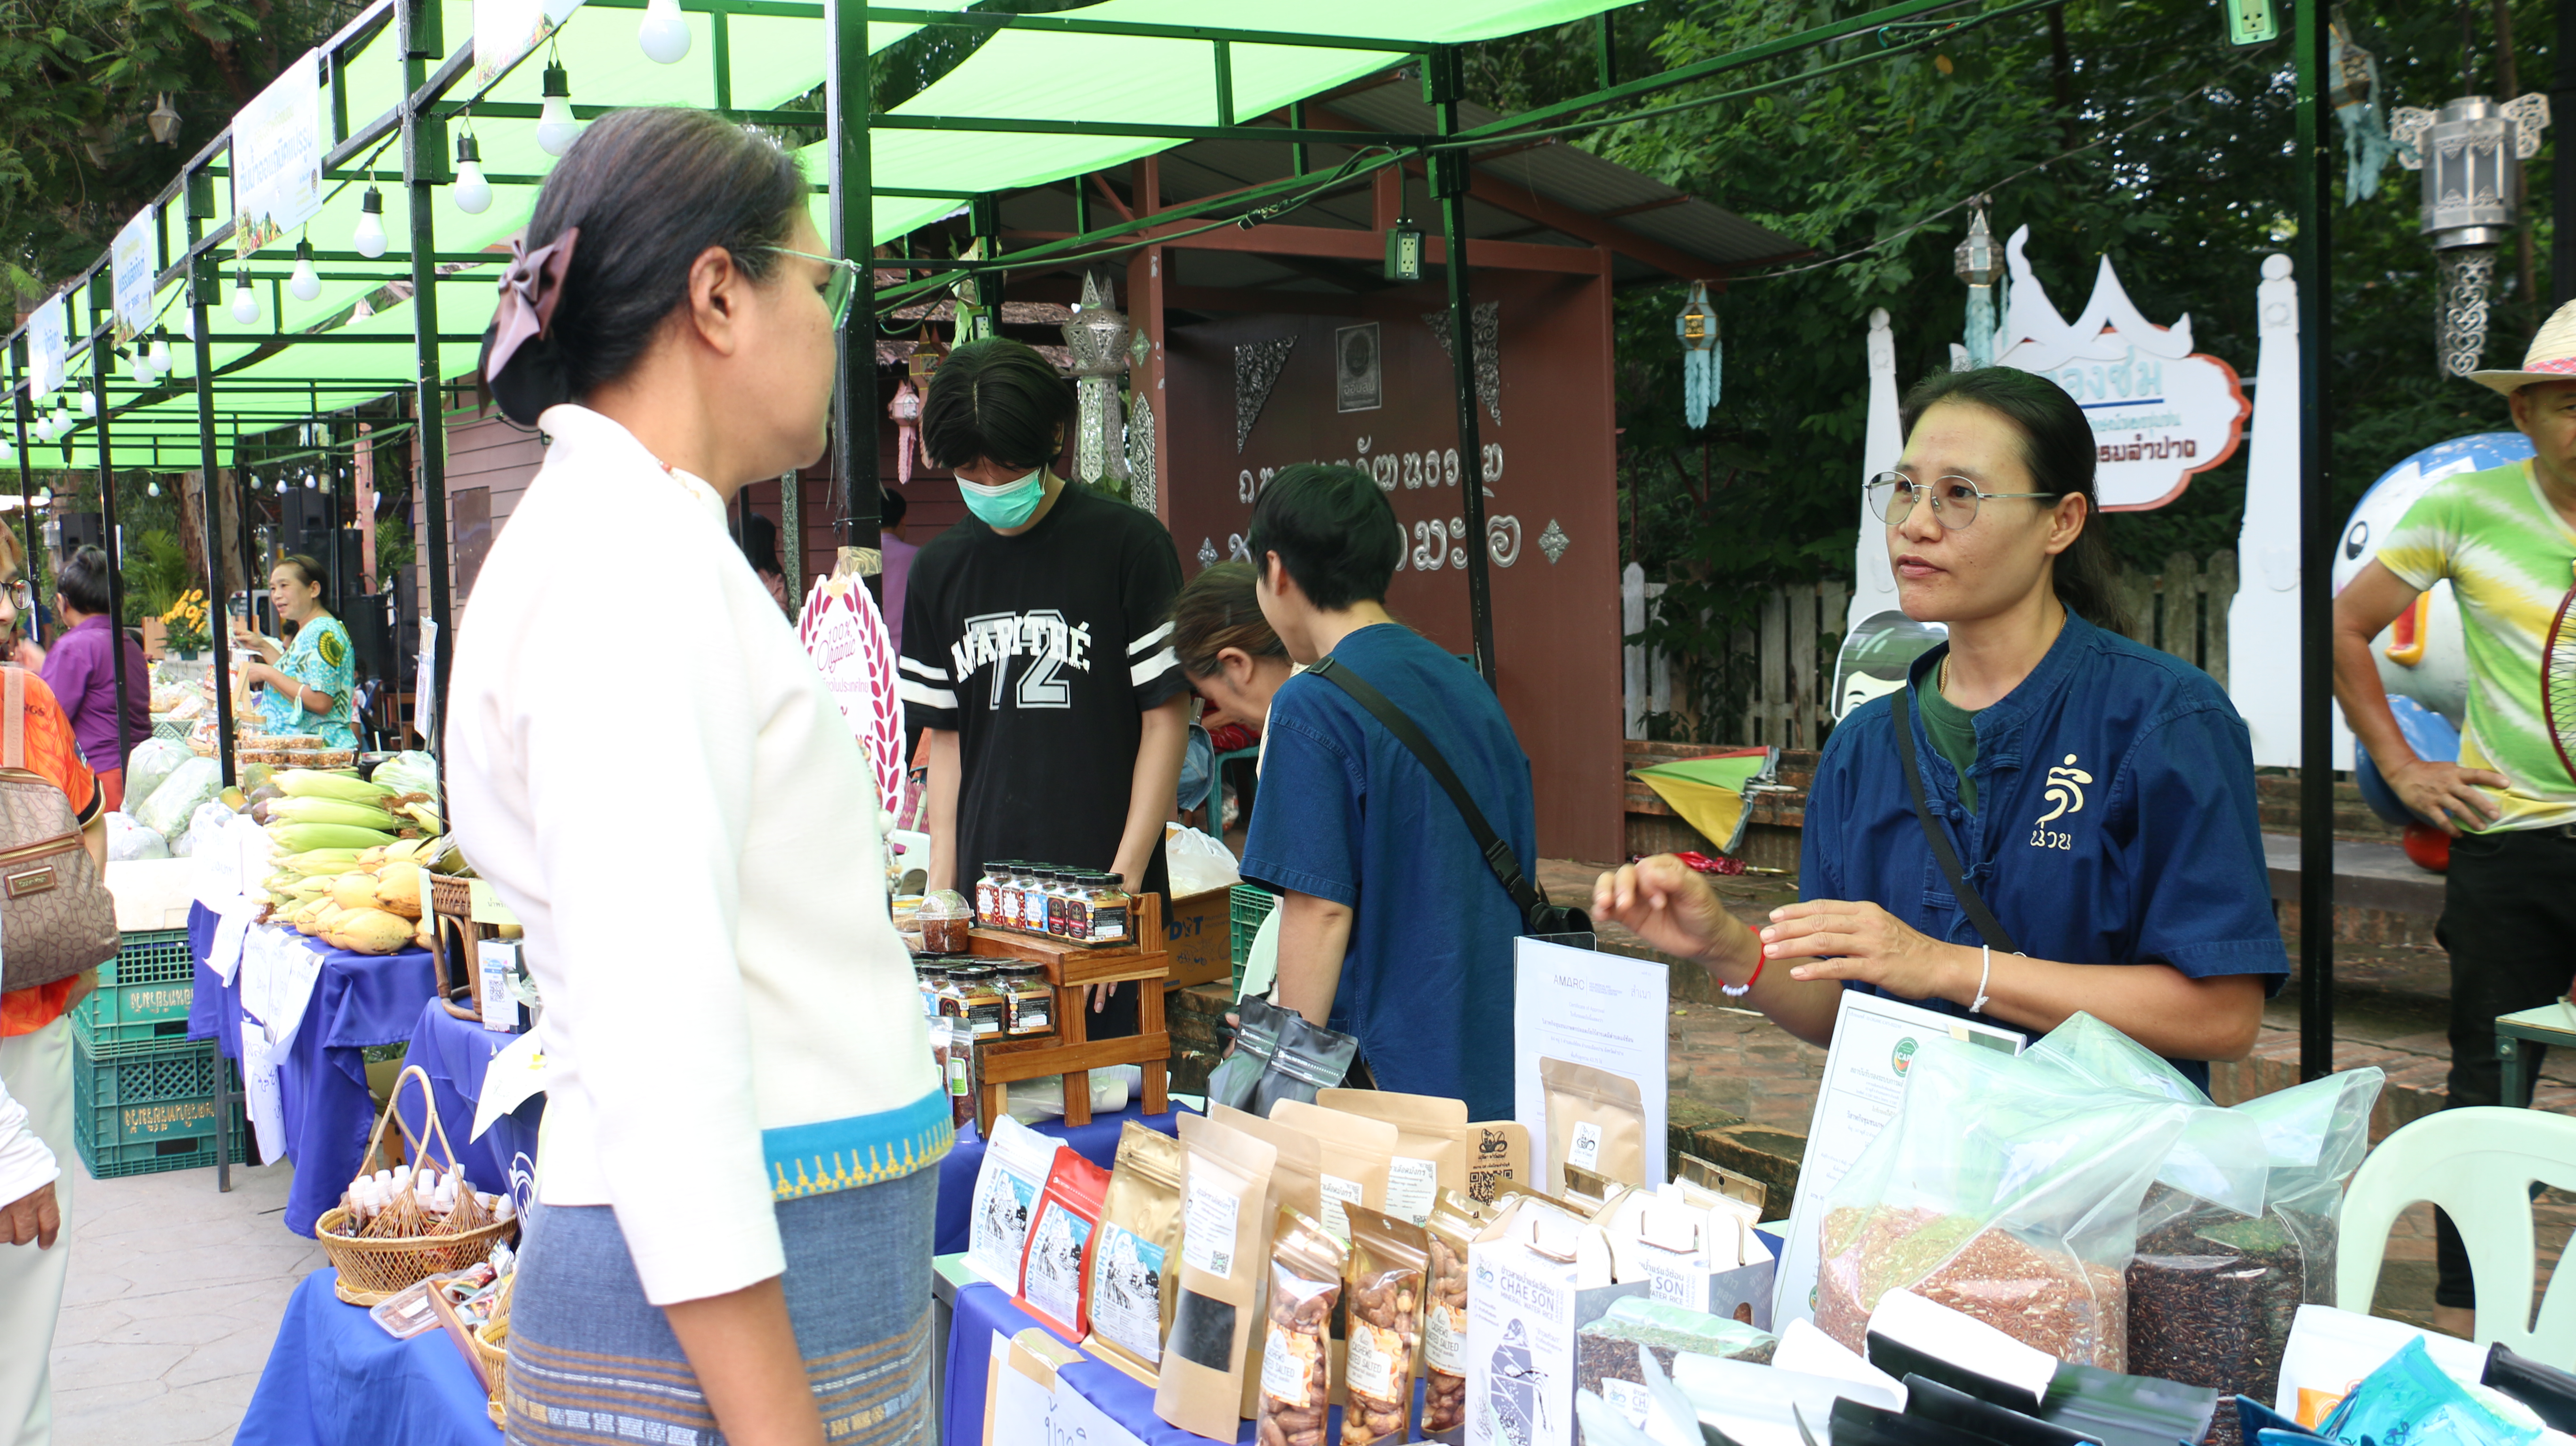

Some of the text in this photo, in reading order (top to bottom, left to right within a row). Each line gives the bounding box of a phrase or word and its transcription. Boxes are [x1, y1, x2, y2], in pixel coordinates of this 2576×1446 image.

[829, 619, 851, 644] 100%
[817, 635, 855, 673] Organic
[965, 609, 1071, 710] 72
[1554, 974, 1585, 990] AMARC
[1631, 985, 1651, 999] สำเนา
[1896, 1052, 1912, 1062] ICAP
[979, 1185, 992, 1220] CHAE
[1033, 1221, 1049, 1261] CHAE
[1639, 1259, 1684, 1281] น้ำแร่แจ้ซ้อน
[1093, 1246, 1109, 1321] CHAE SON
[1500, 1277, 1529, 1301] CHAE
[1531, 1290, 1554, 1312] SON
[1656, 1275, 1684, 1297] SON
[1669, 1295, 1684, 1305] RICE
[1440, 1336, 1459, 1352] SALTED
[1362, 1358, 1382, 1374] SALTED
